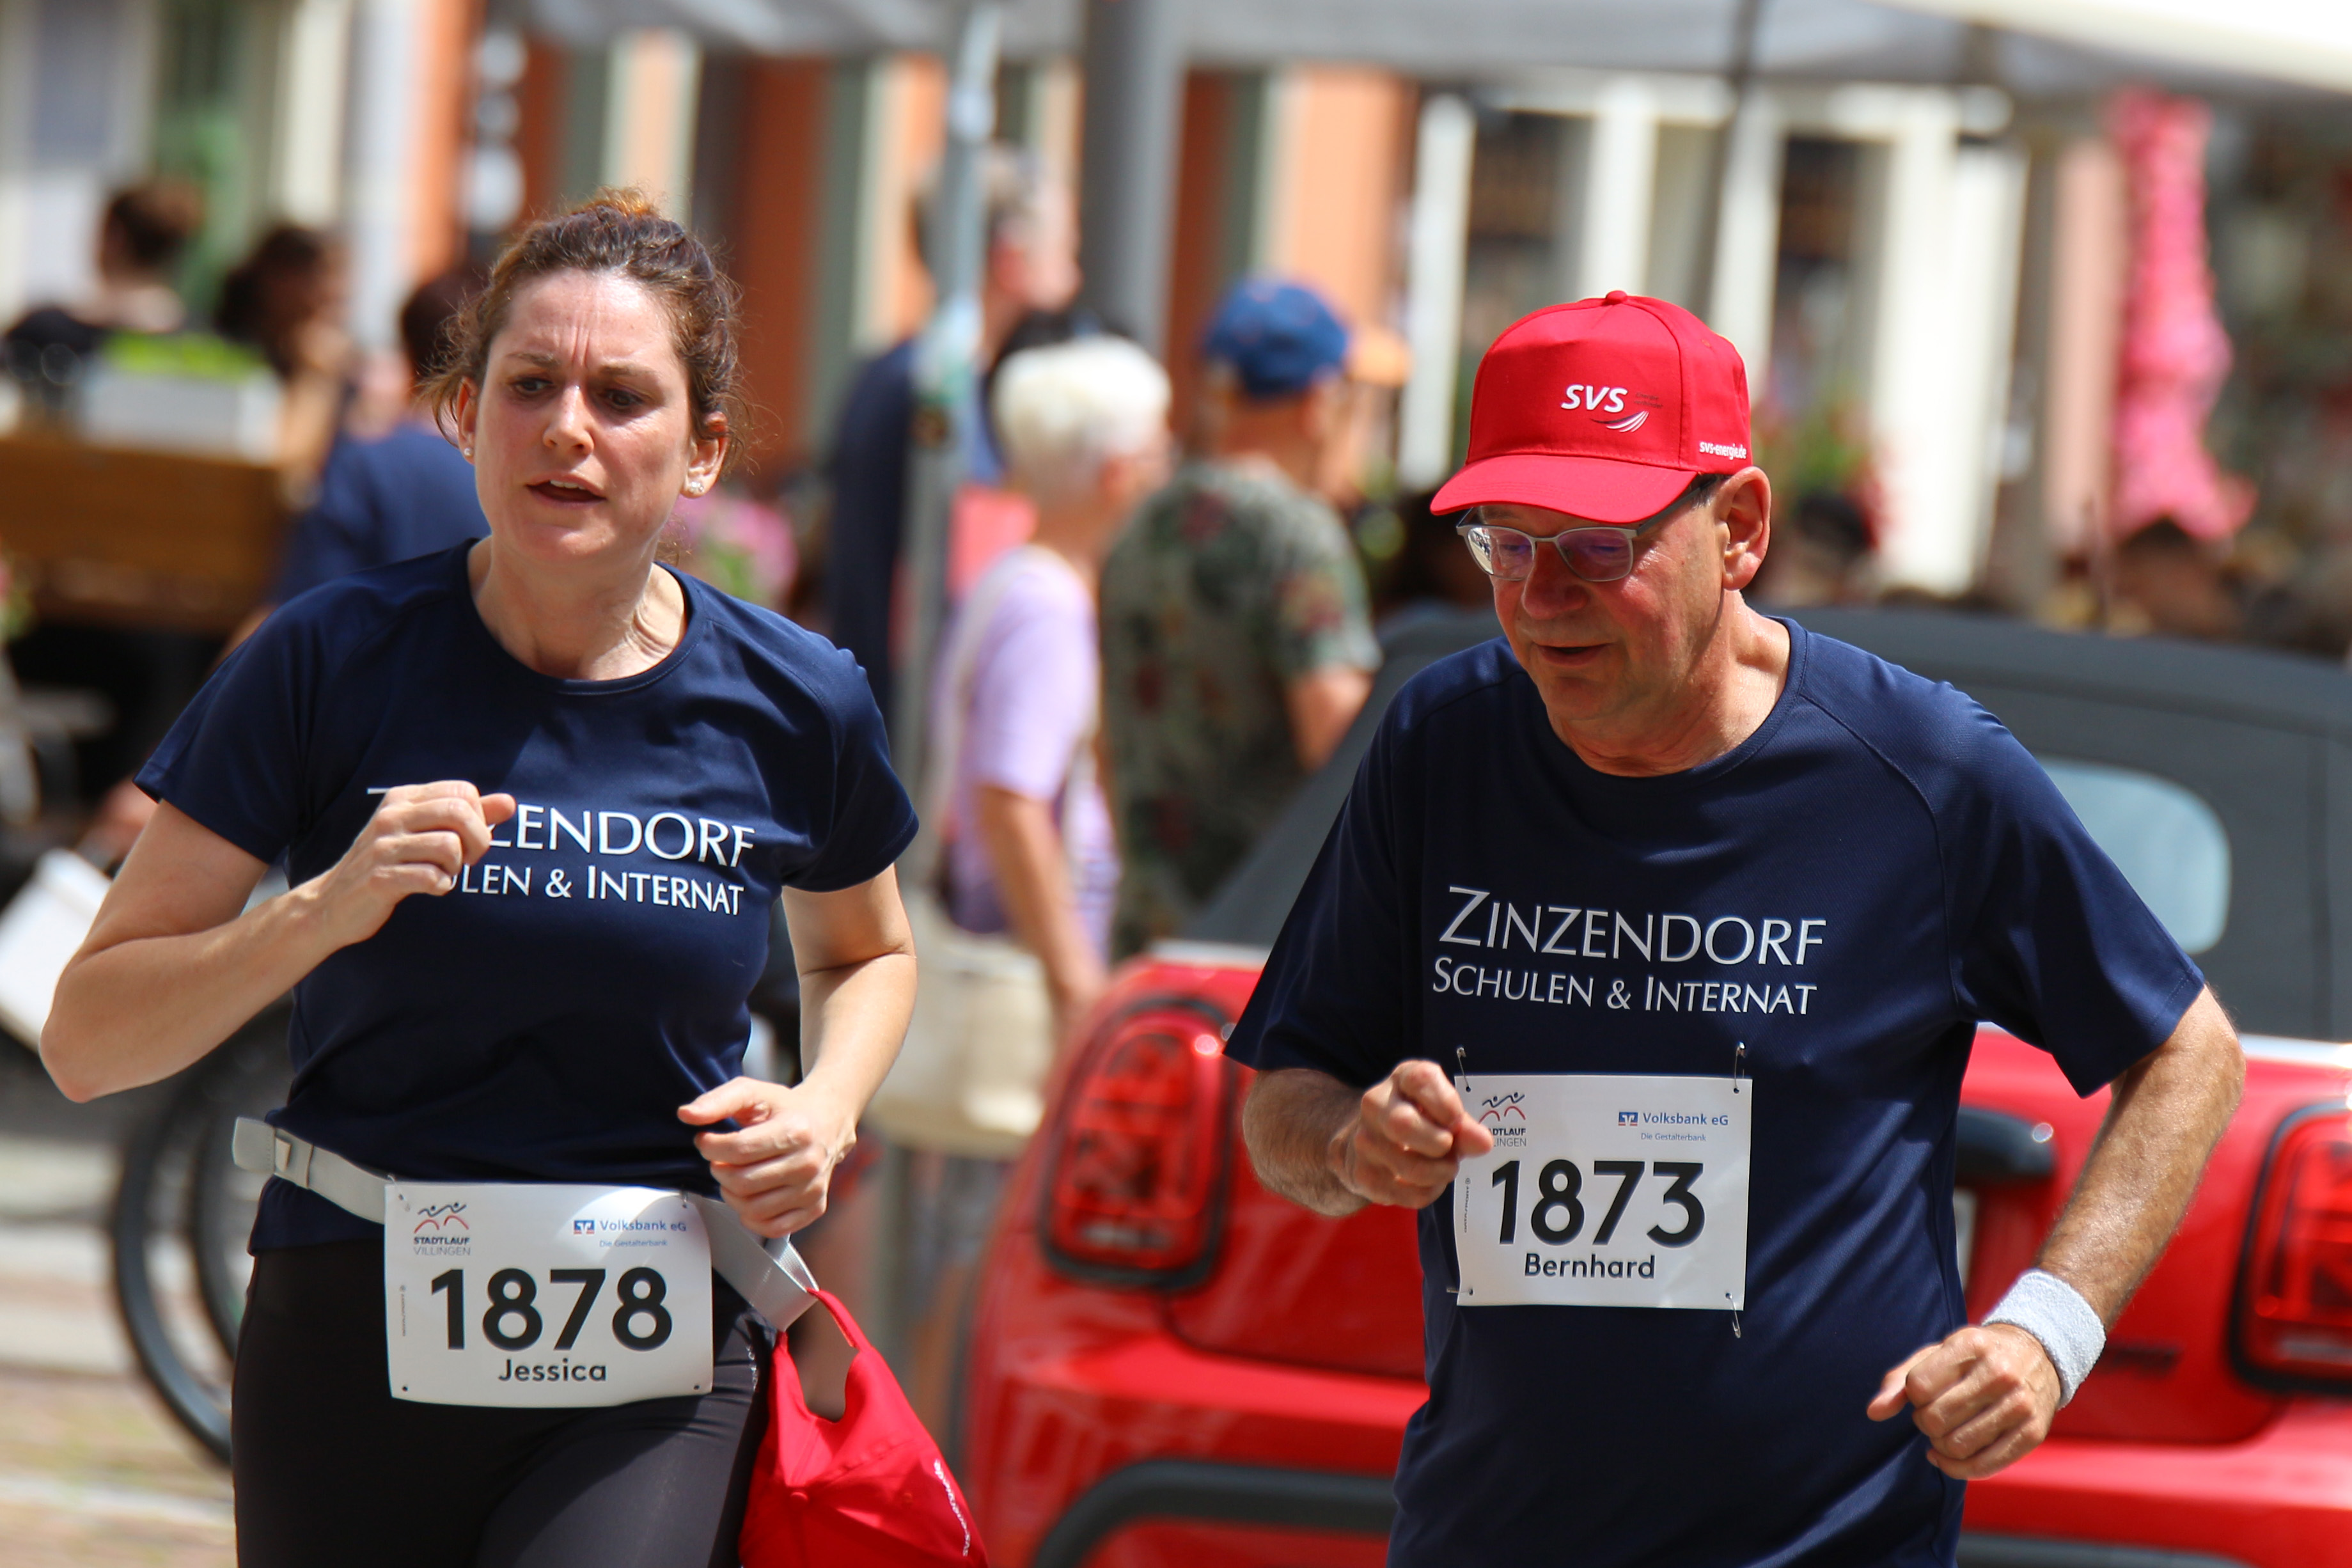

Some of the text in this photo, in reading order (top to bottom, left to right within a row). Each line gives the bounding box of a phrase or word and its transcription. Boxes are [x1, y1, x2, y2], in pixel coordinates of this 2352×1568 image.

[1560, 384, 1628, 413] SVS
[1699, 441, 1747, 460] svs-energie.de
[367, 788, 755, 868] ENDORF
[545, 868, 572, 898] &
[588, 865, 744, 916] INTERNAT
[1439, 886, 1827, 966] ZINZENDORF
[1433, 956, 1817, 1015] SCHULEN & INTERNAT
[1643, 1113, 1729, 1125] Volksbank eG
[1494, 1138, 1527, 1147] INGEN
[1655, 1133, 1707, 1141] Gestalterbank
[1492, 1159, 1705, 1248] 1873
[600, 1219, 687, 1232] Volksbank eG
[413, 1236, 470, 1245] STADTLAUF
[413, 1246, 471, 1256] VILLINGEN
[1525, 1253, 1656, 1279] Bernhard
[431, 1267, 673, 1351] 1878
[498, 1358, 607, 1381] Jessica
